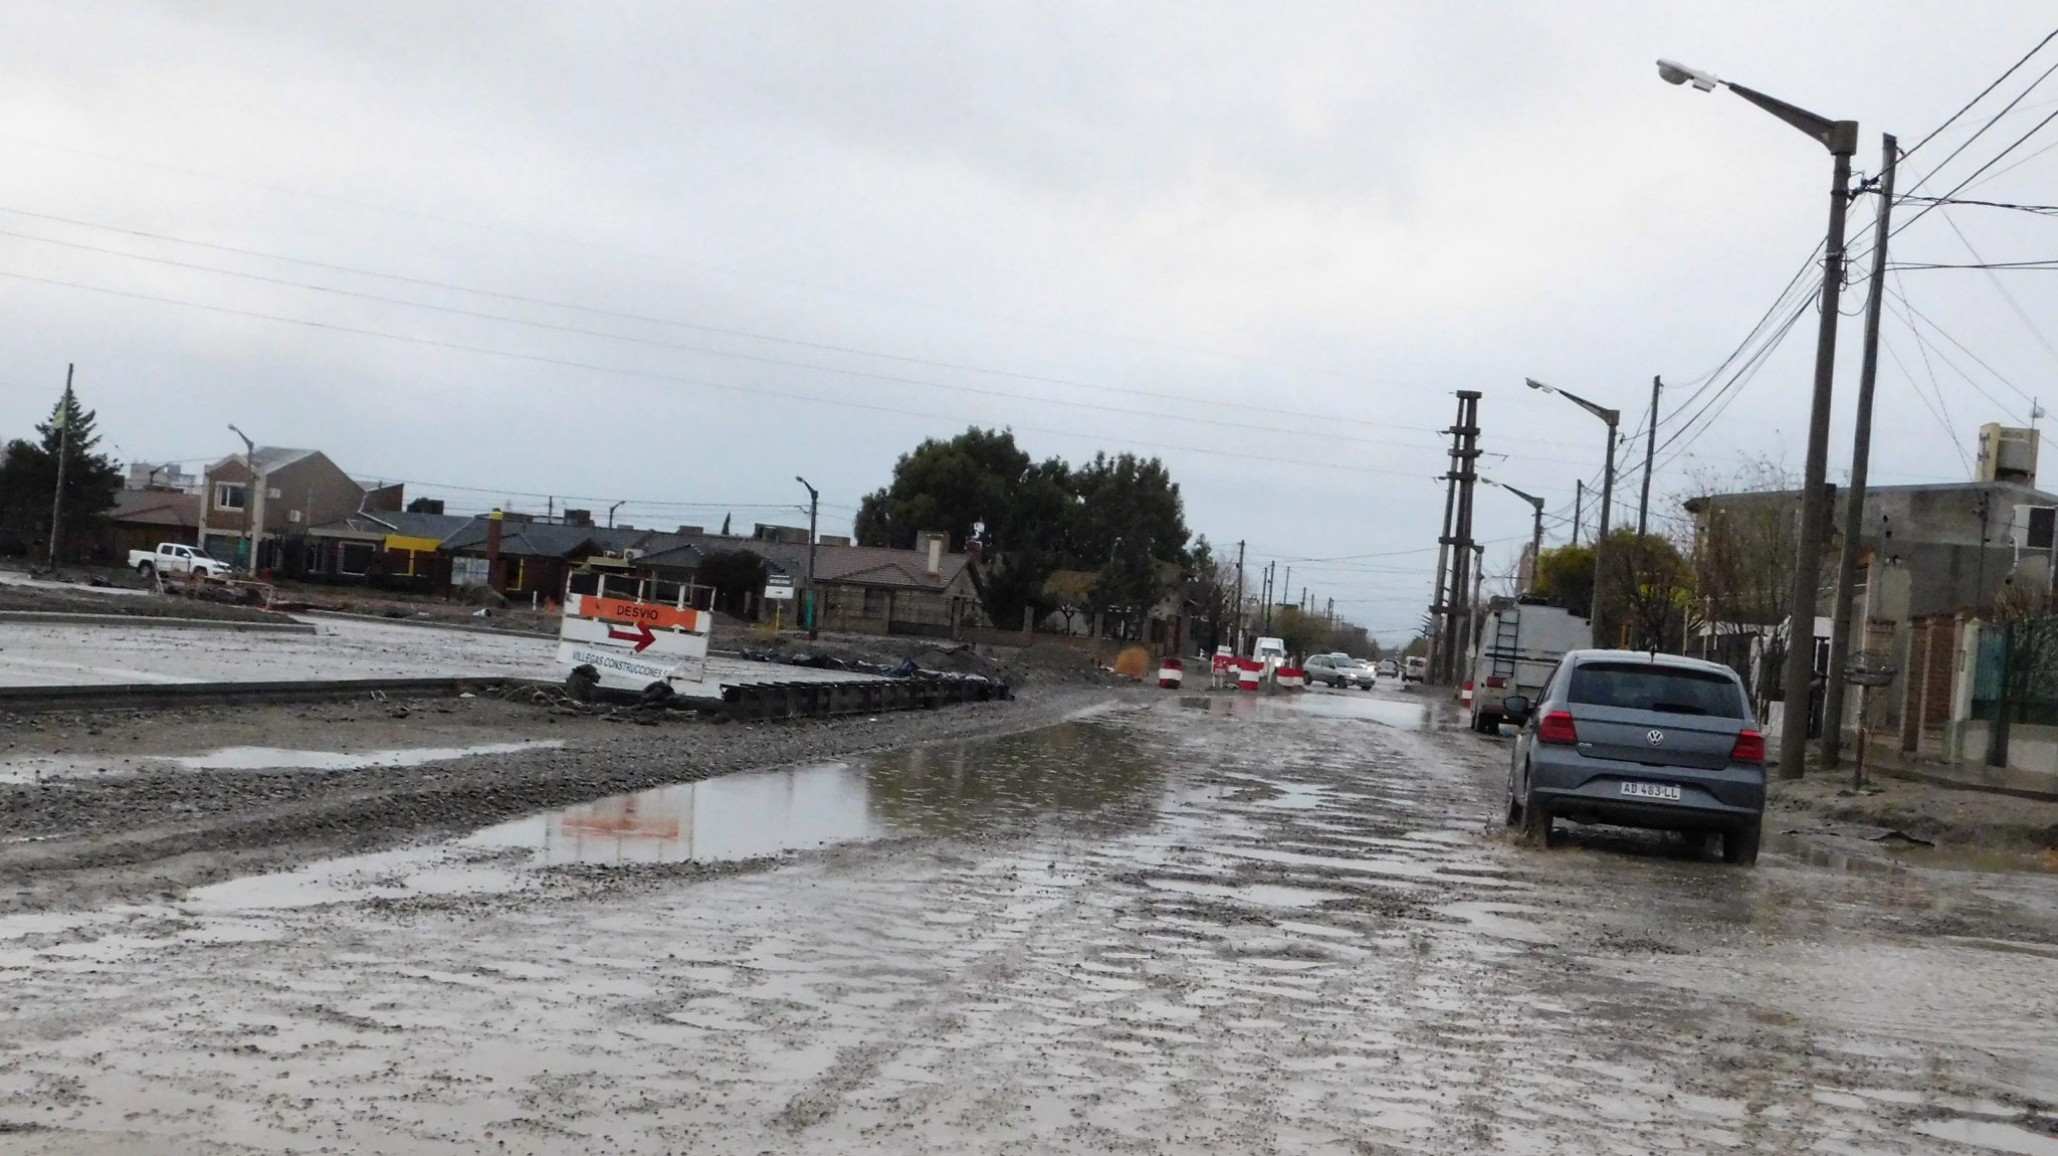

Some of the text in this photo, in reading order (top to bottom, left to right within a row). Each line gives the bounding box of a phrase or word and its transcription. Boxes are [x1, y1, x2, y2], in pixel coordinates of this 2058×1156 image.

[617, 604, 659, 620] DESVIO
[572, 650, 604, 665] VILLEGAS
[604, 657, 663, 678] CONSTRUCCIONES
[1623, 783, 1679, 798] AD 483 LL
